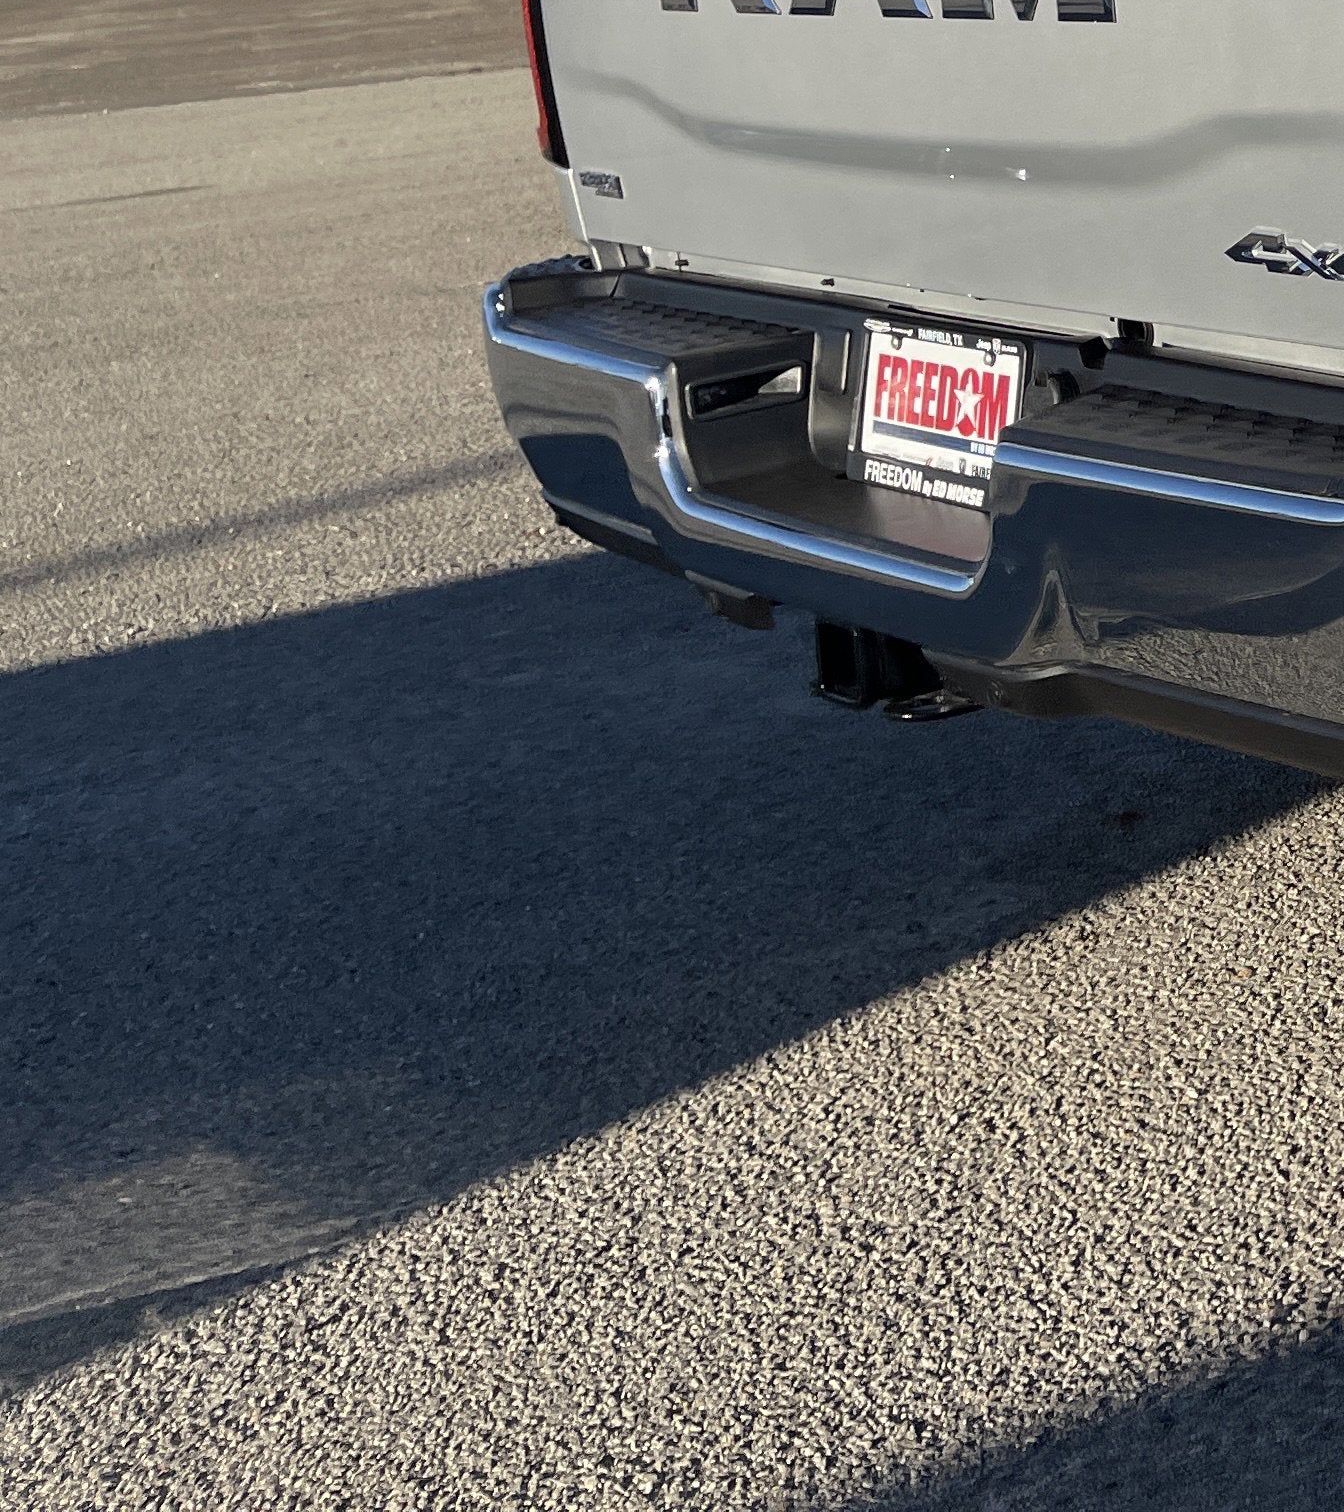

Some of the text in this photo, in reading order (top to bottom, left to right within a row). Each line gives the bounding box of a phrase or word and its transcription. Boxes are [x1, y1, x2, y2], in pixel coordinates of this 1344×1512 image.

[952, 333, 964, 346] TX
[874, 353, 1011, 441] FREEDOM
[864, 459, 923, 493] FREEDOM
[932, 479, 947, 498] ED
[945, 482, 985, 507] MORSE
